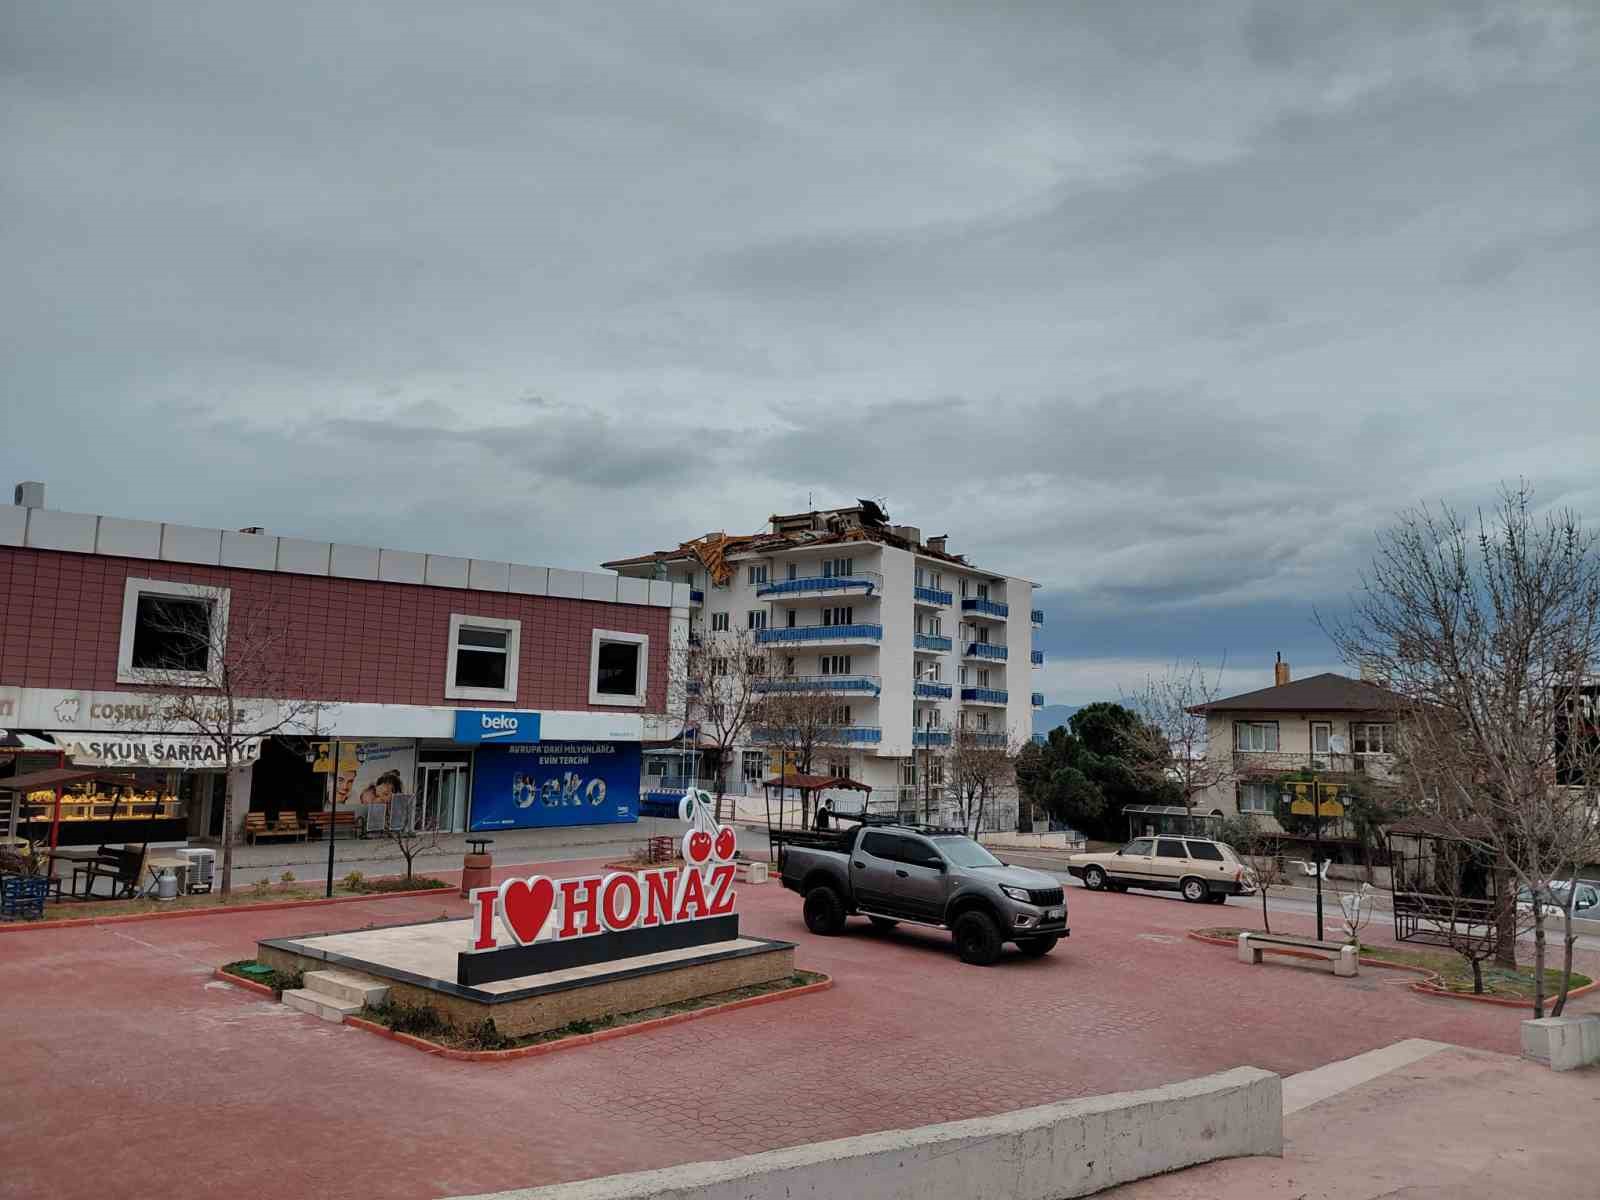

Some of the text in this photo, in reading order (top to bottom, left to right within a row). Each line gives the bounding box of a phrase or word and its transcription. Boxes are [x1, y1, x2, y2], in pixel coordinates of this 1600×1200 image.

[481, 714, 518, 730] beko
[513, 772, 607, 808] beko
[473, 864, 737, 951] I HONAZ
